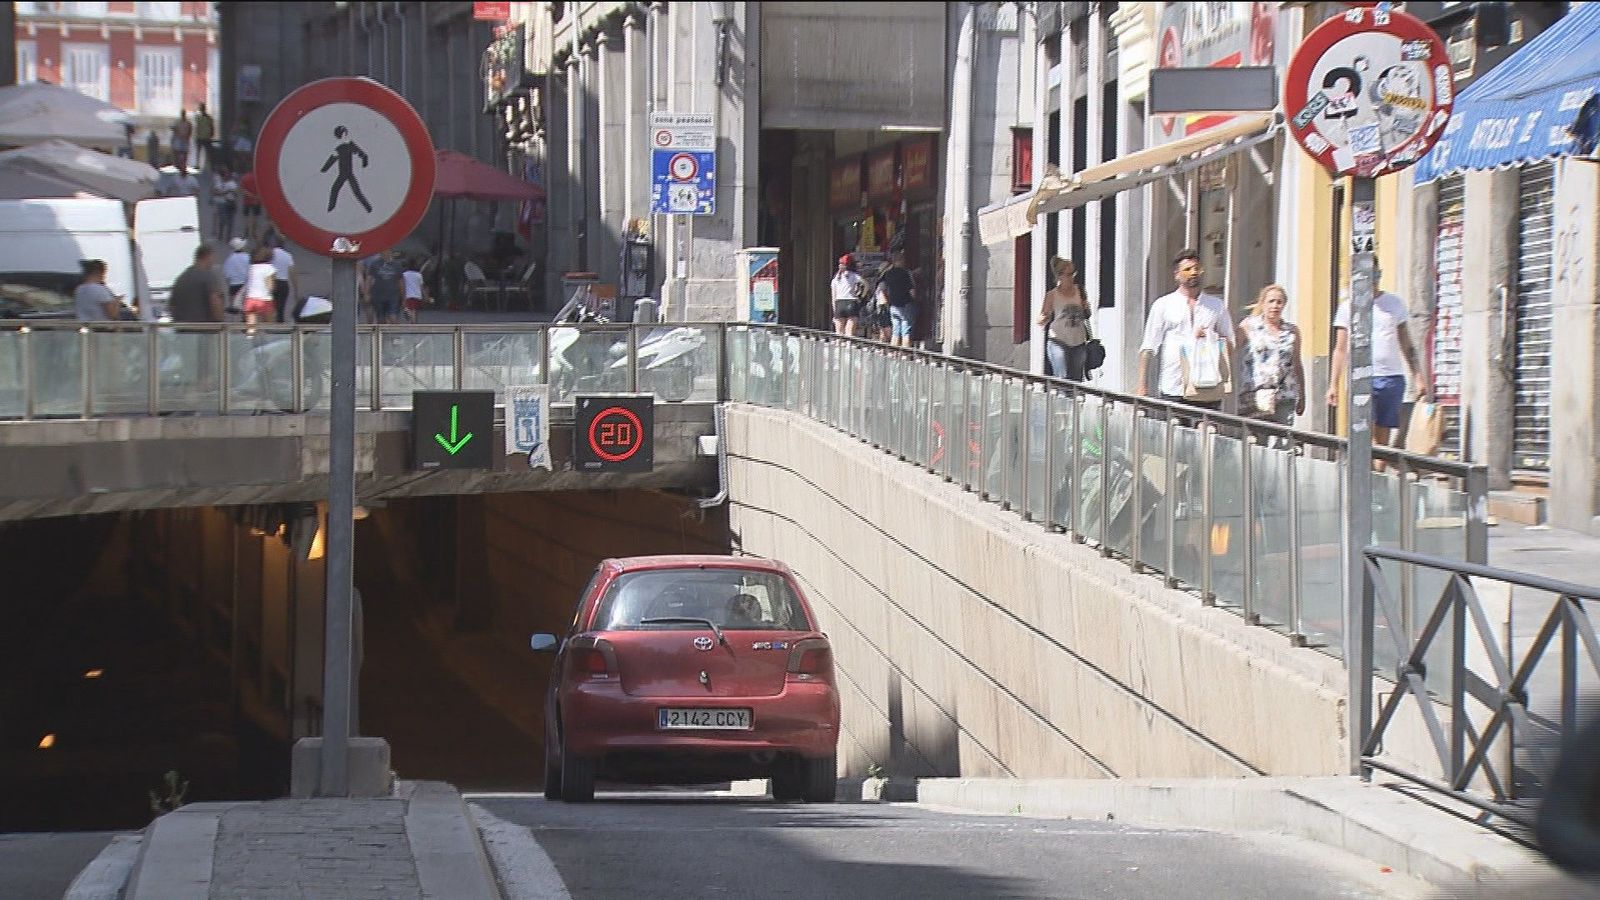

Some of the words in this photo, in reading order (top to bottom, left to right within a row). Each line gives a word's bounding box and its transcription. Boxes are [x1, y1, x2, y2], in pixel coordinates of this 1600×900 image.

[601, 422, 631, 445] 20
[671, 711, 711, 727] 2142
[716, 711, 745, 727] CCY
